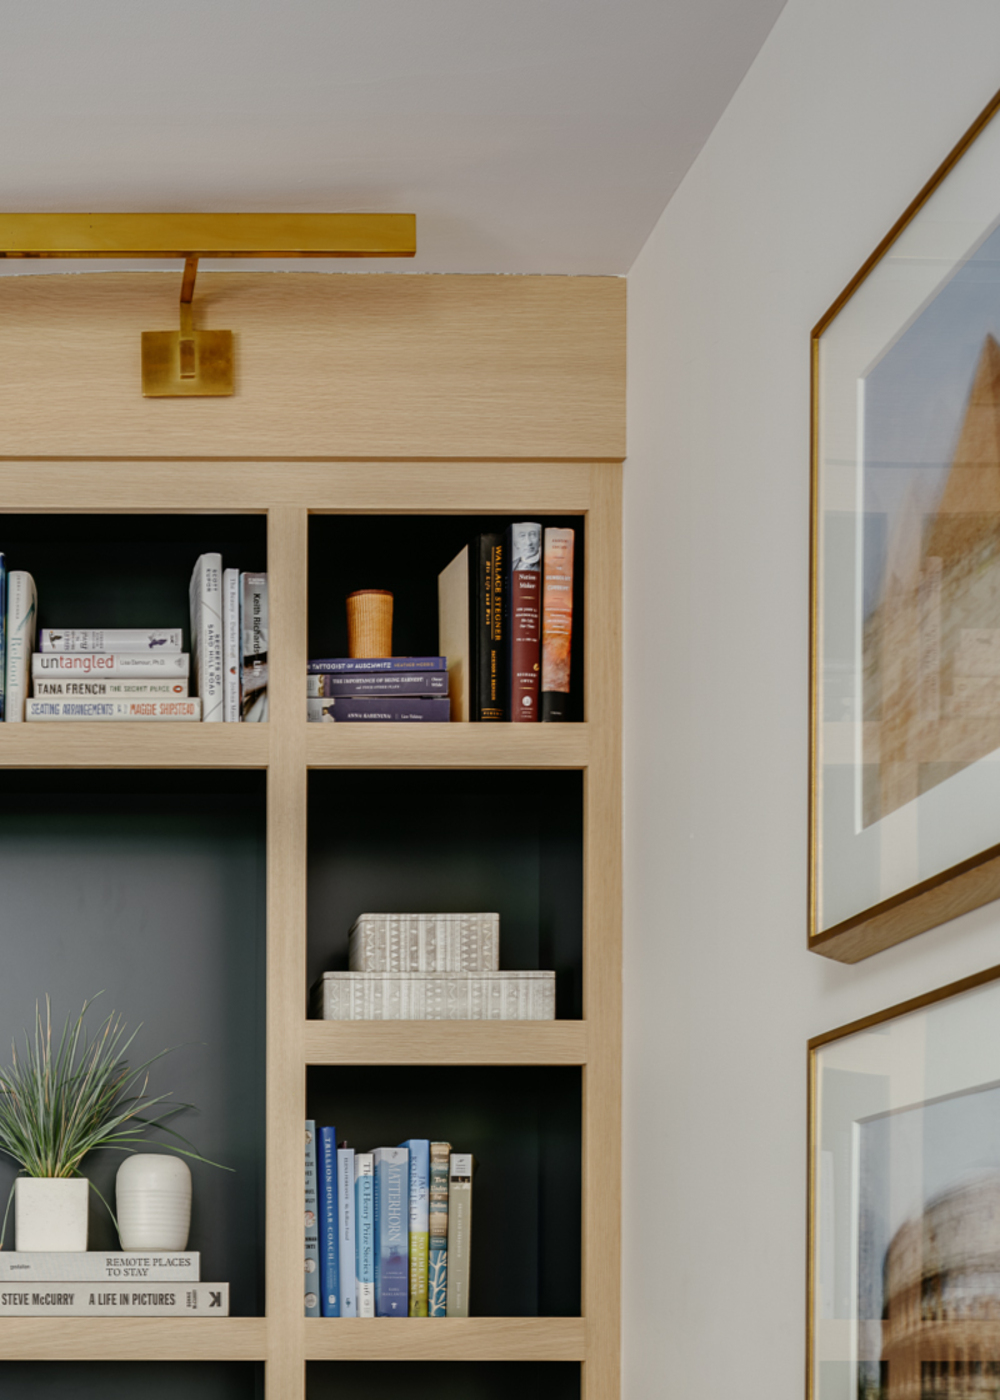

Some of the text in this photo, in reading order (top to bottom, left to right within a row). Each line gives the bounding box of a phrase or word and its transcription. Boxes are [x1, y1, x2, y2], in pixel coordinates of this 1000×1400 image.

[252, 593, 261, 615] Keith
[252, 617, 261, 652] Richards
[9, 637, 22, 687] Reboot
[40, 655, 114, 673] untangled
[253, 660, 262, 677] Life
[311, 662, 392, 670] TATTOOIST AUSCHWITZ
[37, 683, 106, 694] TANA FRENCH
[214, 674, 221, 687] OF
[31, 703, 60, 715] SEATING
[62, 703, 113, 715] ARRANGEMENTS
[130, 703, 156, 715] MAGGIE
[159, 703, 195, 715] SHIPSTEAD
[324, 1138, 332, 1182] TRILLION
[363, 1162, 371, 1178] The
[418, 1175, 426, 1200] JACK
[361, 1193, 371, 1220] Henry
[388, 1163, 401, 1241] MATTERHORN
[363, 1223, 371, 1245] Prize
[418, 1237, 425, 1250] NO
[106, 1258, 191, 1267] REMOTE PLACES
[363, 1246, 371, 1275] Stories
[106, 1268, 149, 1277] TO STAY
[1, 1293, 75, 1306] STEVE McCURRY
[88, 1293, 95, 1306] A
[98, 1293, 117, 1306] LIFE
[119, 1293, 130, 1306] IN
[132, 1293, 176, 1306] PICTURES
